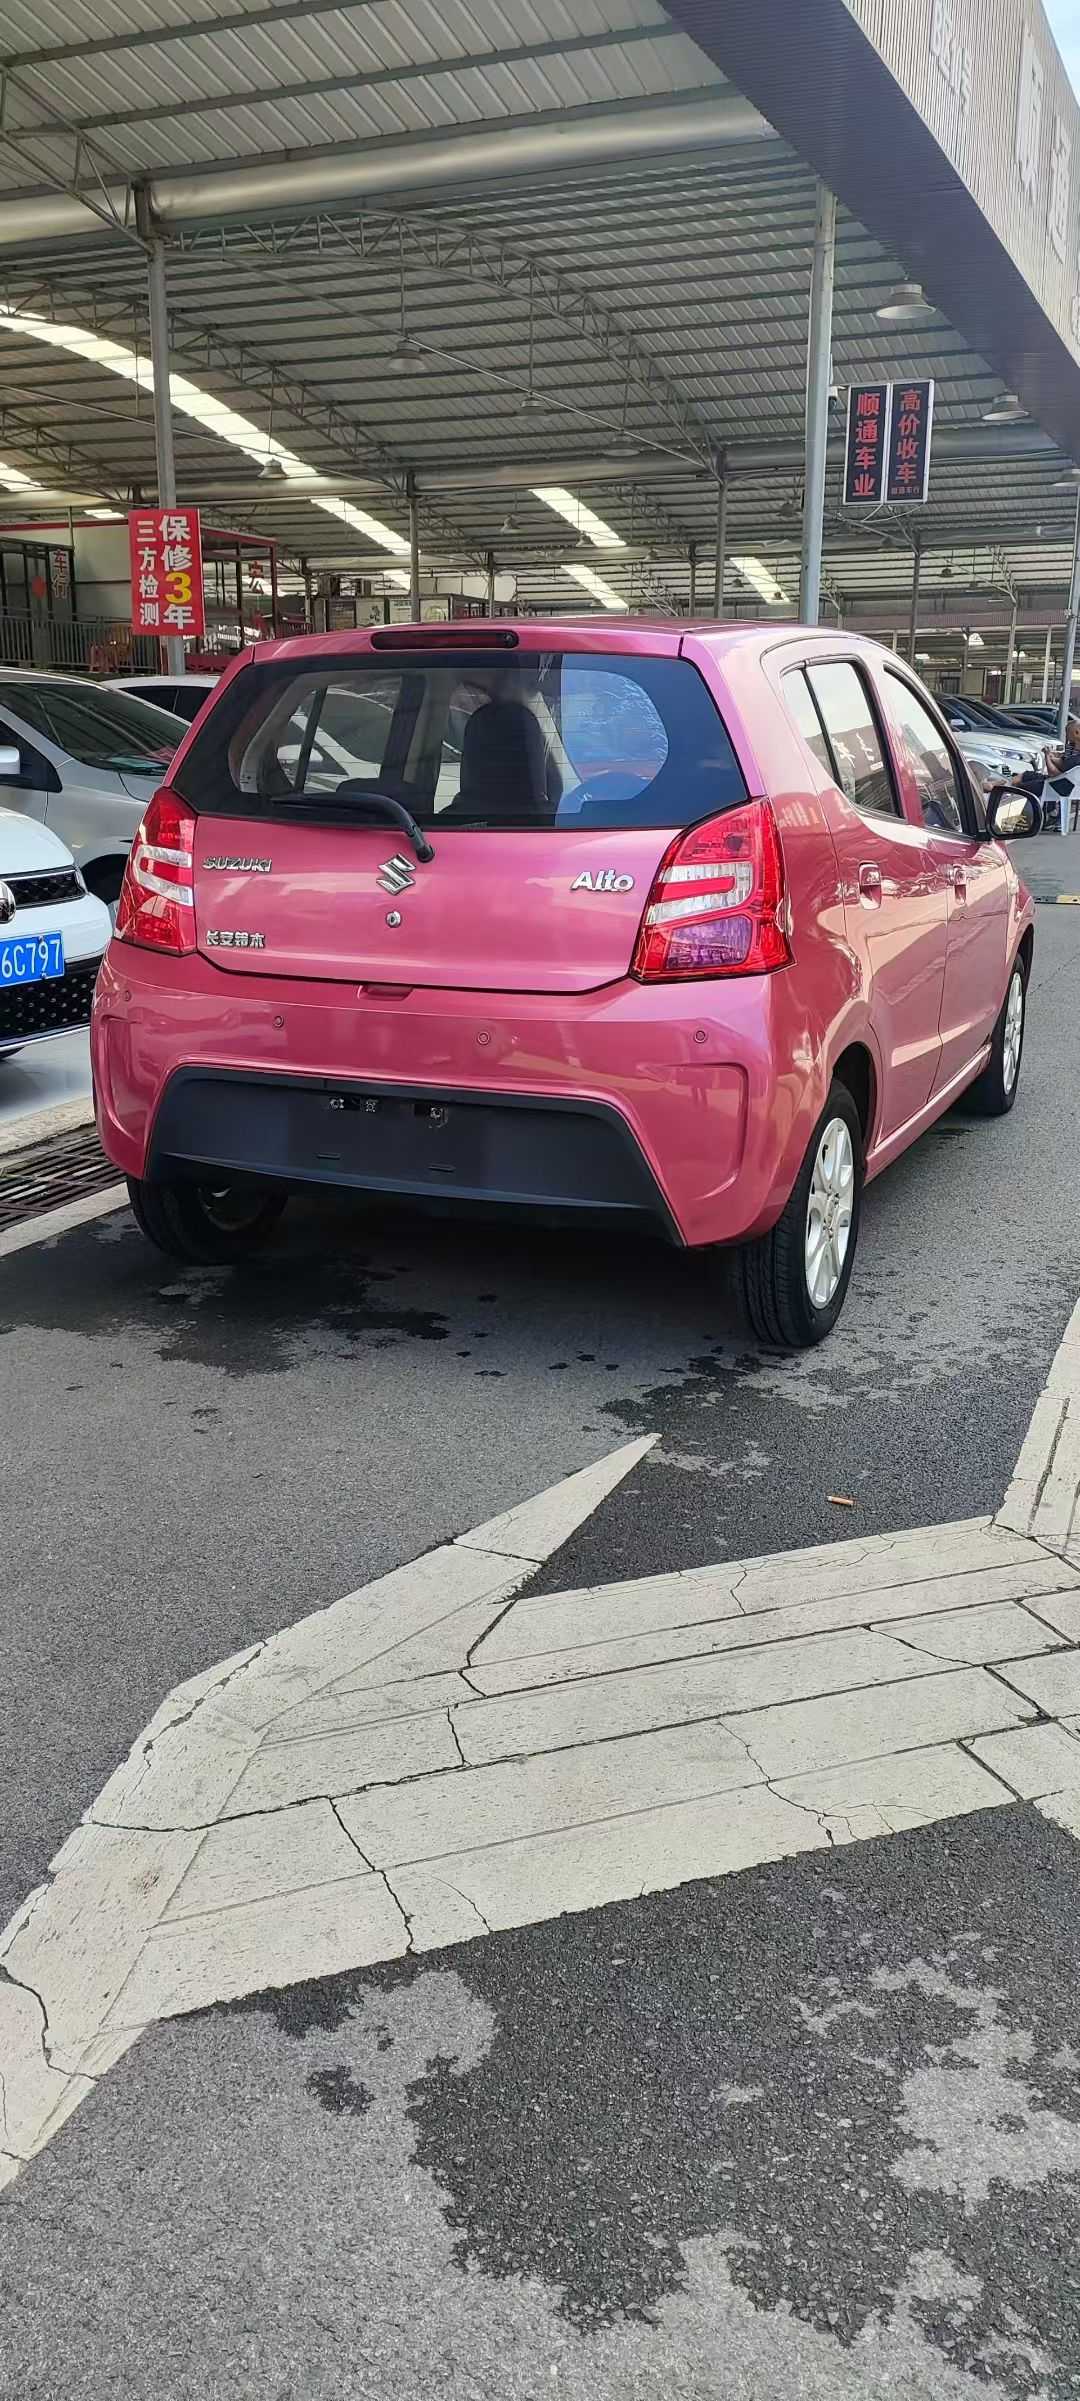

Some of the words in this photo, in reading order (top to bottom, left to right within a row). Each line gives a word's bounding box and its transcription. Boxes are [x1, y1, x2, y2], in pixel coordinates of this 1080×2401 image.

[852, 391, 880, 496] 顺通车业
[895, 388, 922, 484] 高价收车
[136, 520, 159, 626] 三方检测
[158, 515, 196, 629] 保修3年
[202, 857, 272, 872] SUZUKI
[571, 869, 634, 892] Alto
[1, 939, 61, 978] 6C797
